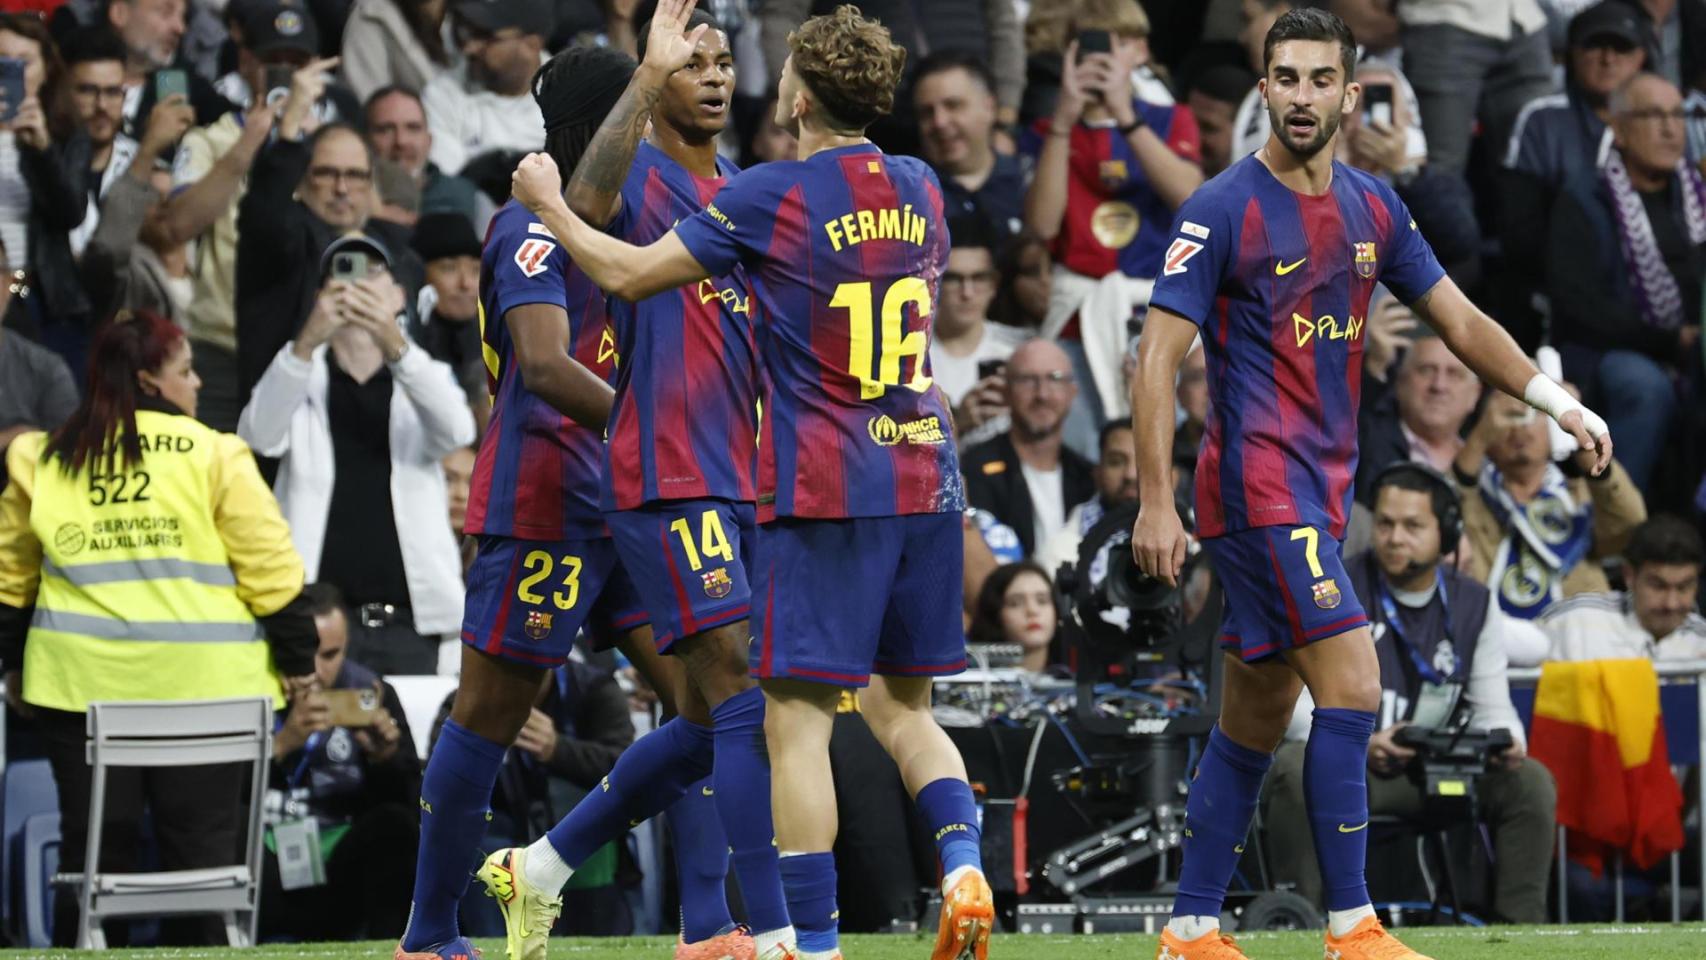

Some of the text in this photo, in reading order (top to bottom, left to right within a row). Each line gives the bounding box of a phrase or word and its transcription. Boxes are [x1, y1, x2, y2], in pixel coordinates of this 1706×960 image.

[824, 203, 927, 253] FERMÍN
[828, 276, 934, 401] 16
[89, 471, 151, 507] 522
[89, 535, 183, 551] AUXILIARES
[93, 517, 179, 533] SERVICIOS
[670, 509, 735, 572] 14
[1290, 526, 1324, 578] 7
[517, 549, 583, 611] 23
